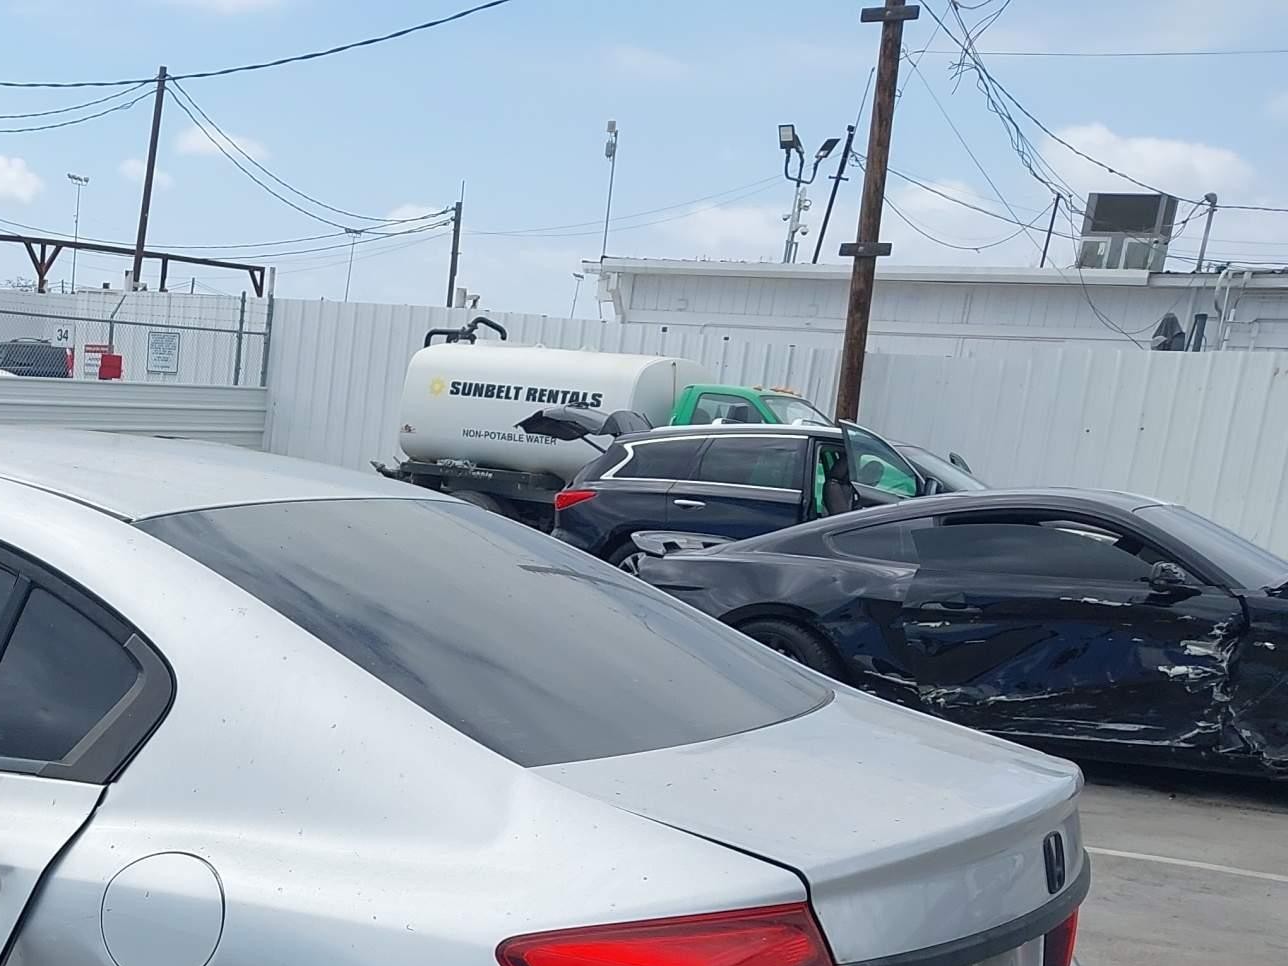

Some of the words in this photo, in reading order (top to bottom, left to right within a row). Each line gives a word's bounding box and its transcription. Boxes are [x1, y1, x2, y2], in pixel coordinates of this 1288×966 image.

[56, 328, 69, 342] 34
[450, 381, 523, 400] SUNBELT
[525, 387, 603, 407] RENTALS
[462, 428, 525, 443] NON-POTABLE
[525, 434, 557, 446] WATER
